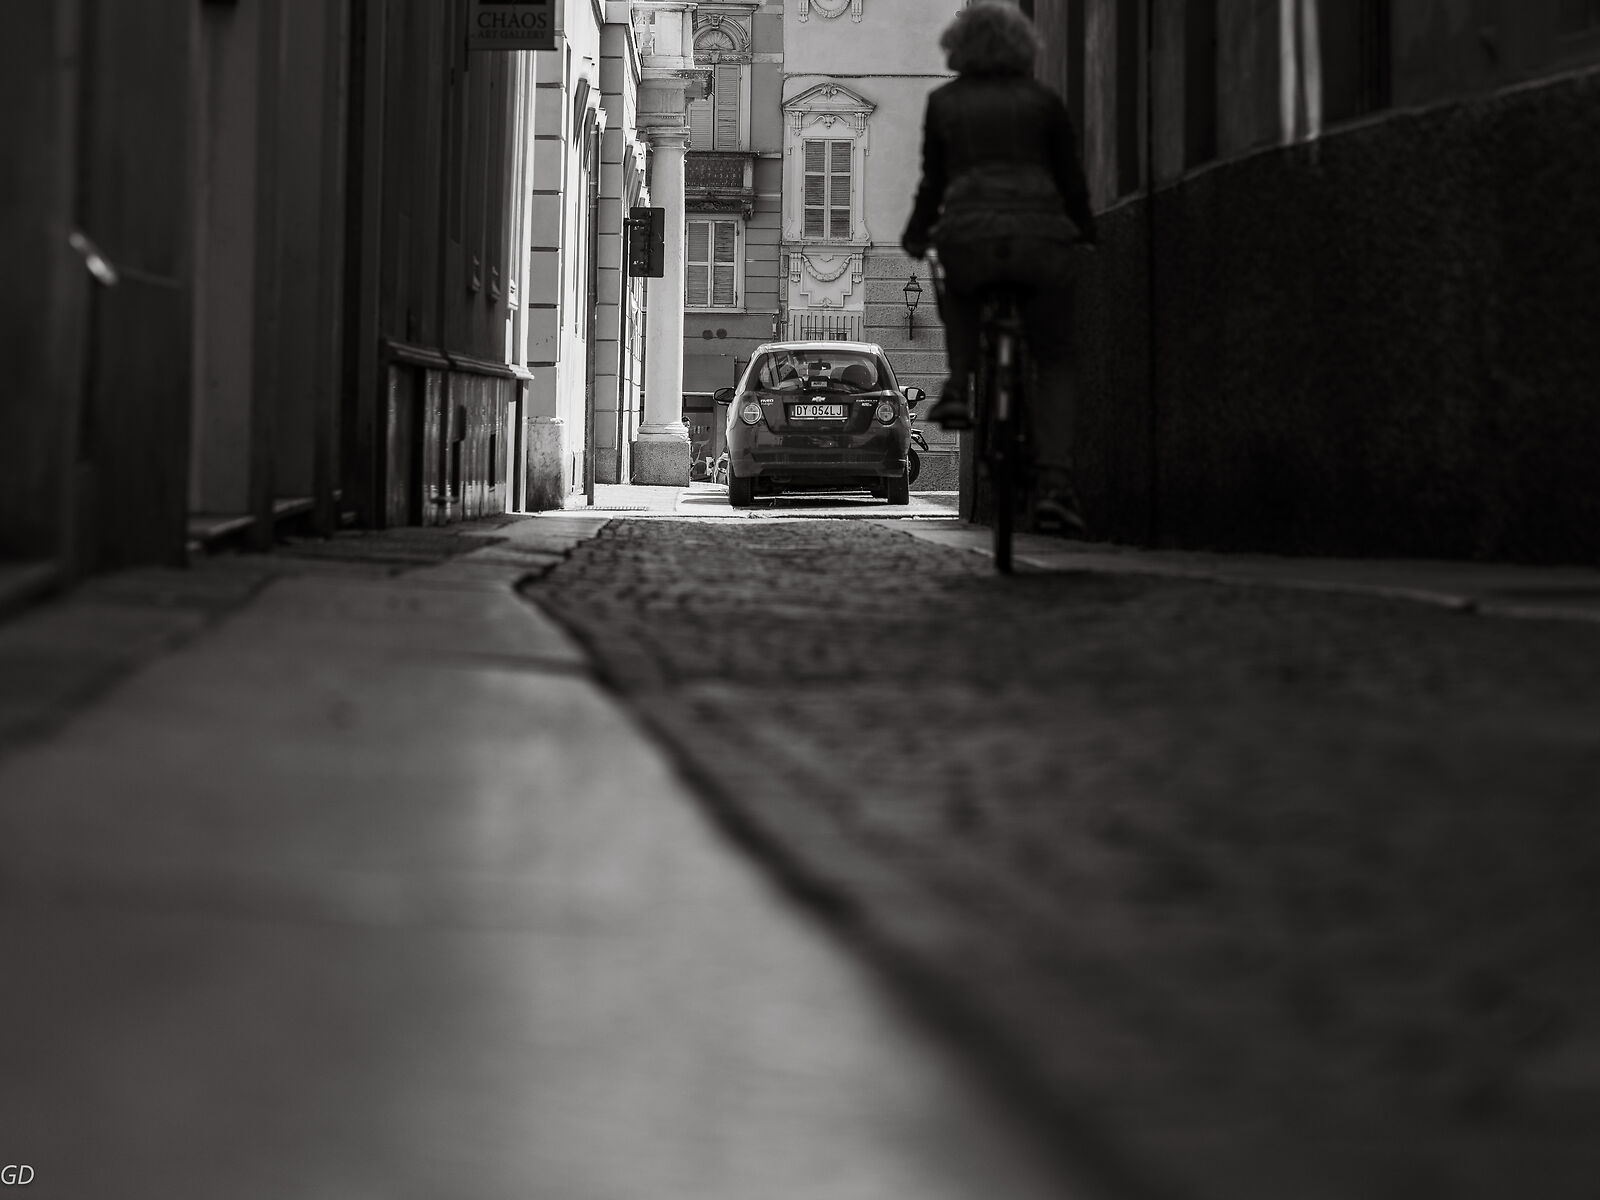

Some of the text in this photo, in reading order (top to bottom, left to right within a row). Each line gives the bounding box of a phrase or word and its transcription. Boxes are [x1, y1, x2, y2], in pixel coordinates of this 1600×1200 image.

[478, 11, 547, 29] CHAOS
[479, 30, 545, 39] ART GALLERY
